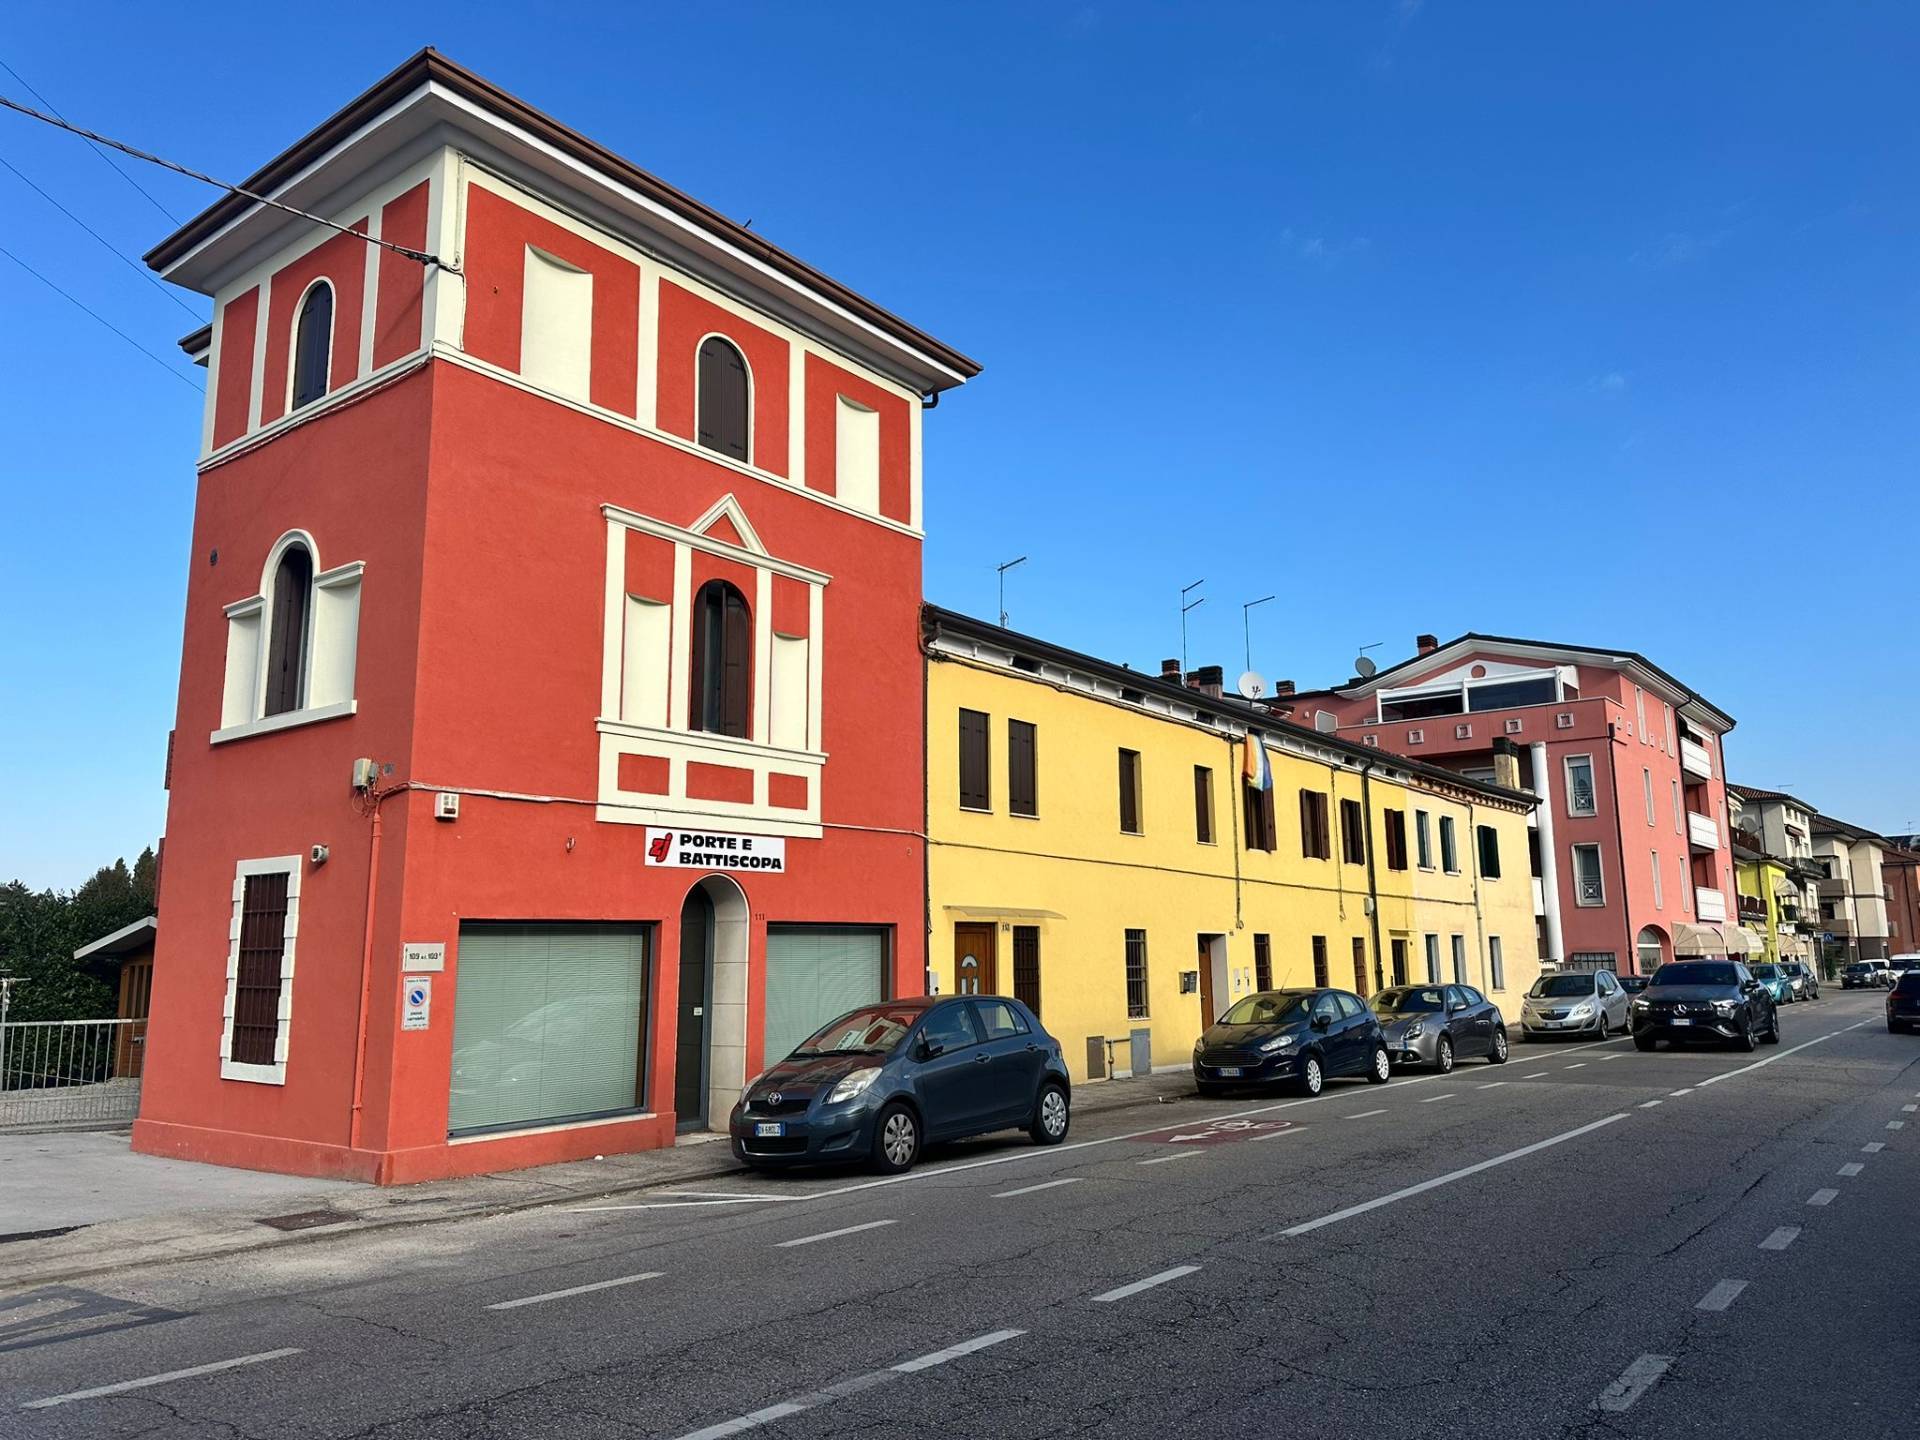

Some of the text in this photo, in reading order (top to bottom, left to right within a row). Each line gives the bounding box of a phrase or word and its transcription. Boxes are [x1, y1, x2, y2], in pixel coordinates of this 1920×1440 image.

[680, 834, 752, 850] PORTE E
[680, 852, 782, 869] BATTISCOPA
